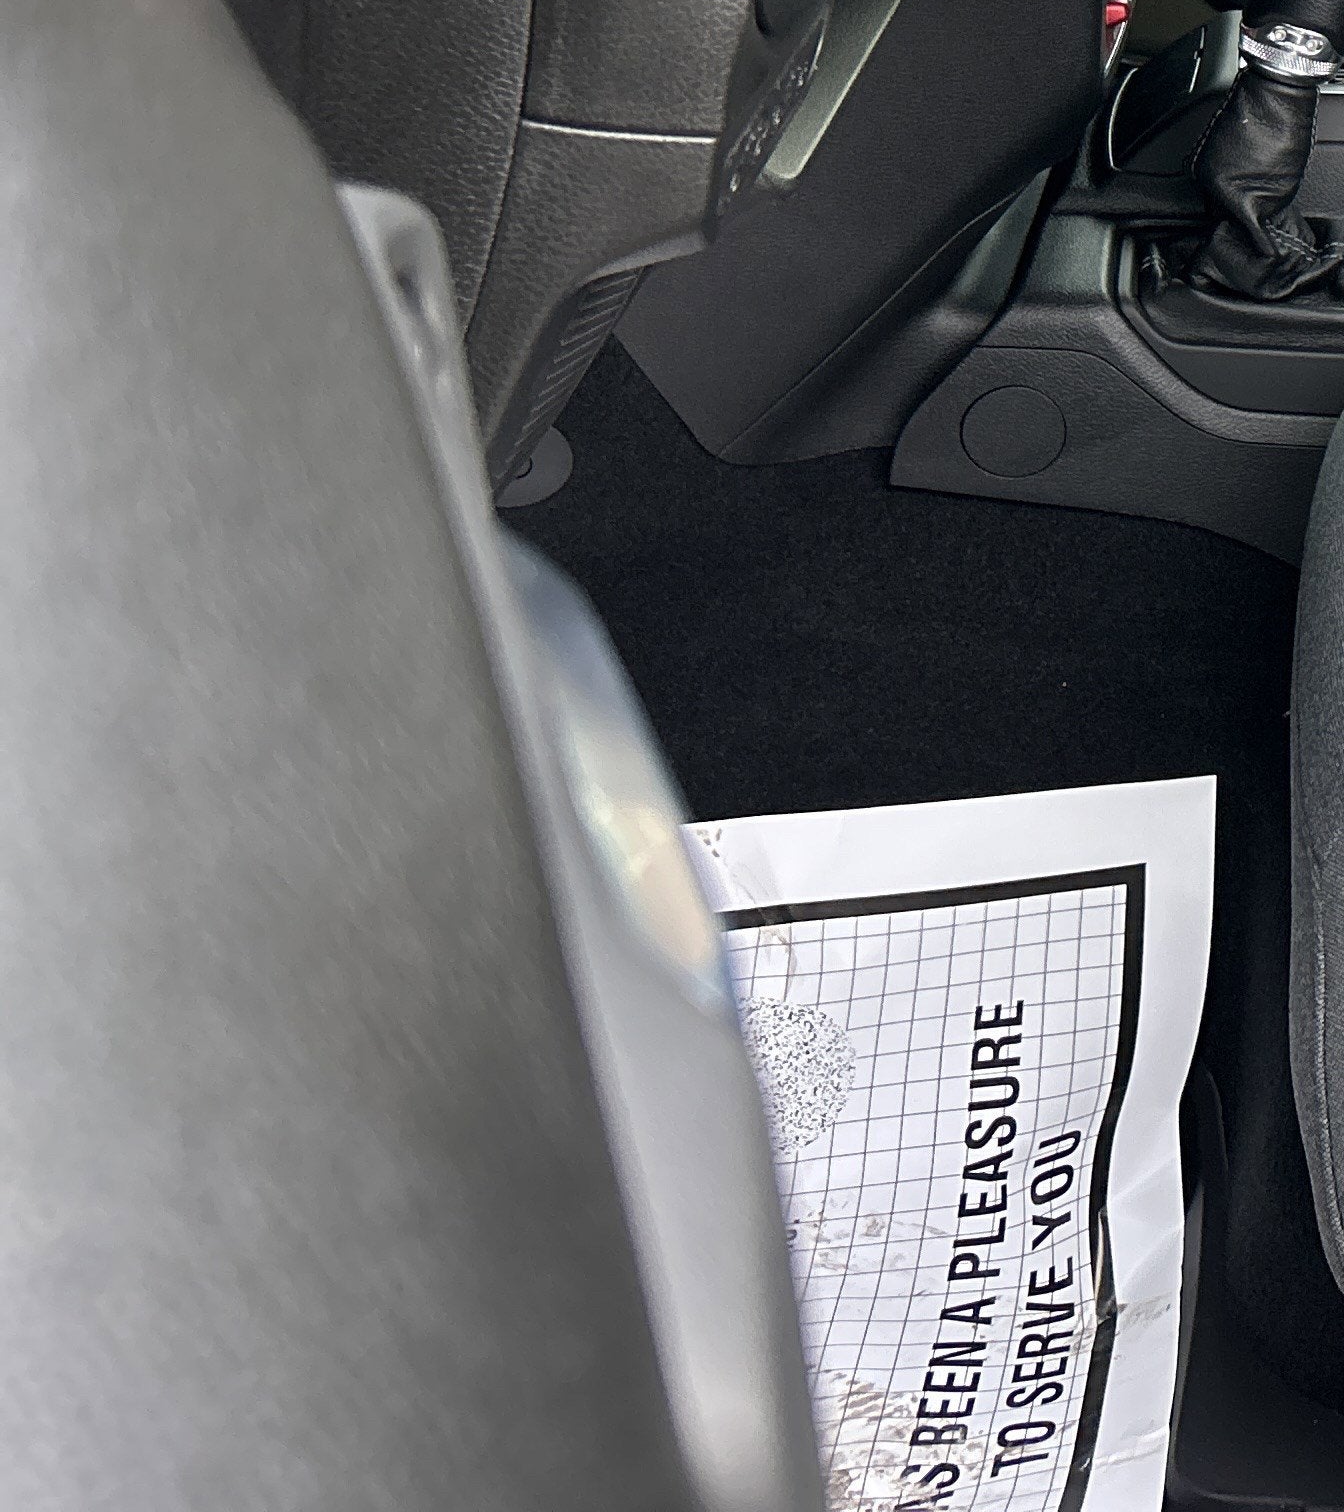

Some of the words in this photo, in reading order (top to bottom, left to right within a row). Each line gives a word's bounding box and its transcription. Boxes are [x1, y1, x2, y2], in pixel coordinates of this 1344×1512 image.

[948, 999, 1025, 1281] PLEASURE
[1031, 1129, 1082, 1249] YOU
[941, 1292, 997, 1325] A
[1006, 1256, 1073, 1405] SERVE
[909, 1338, 987, 1447] BEEN
[990, 1420, 1056, 1478] TO
